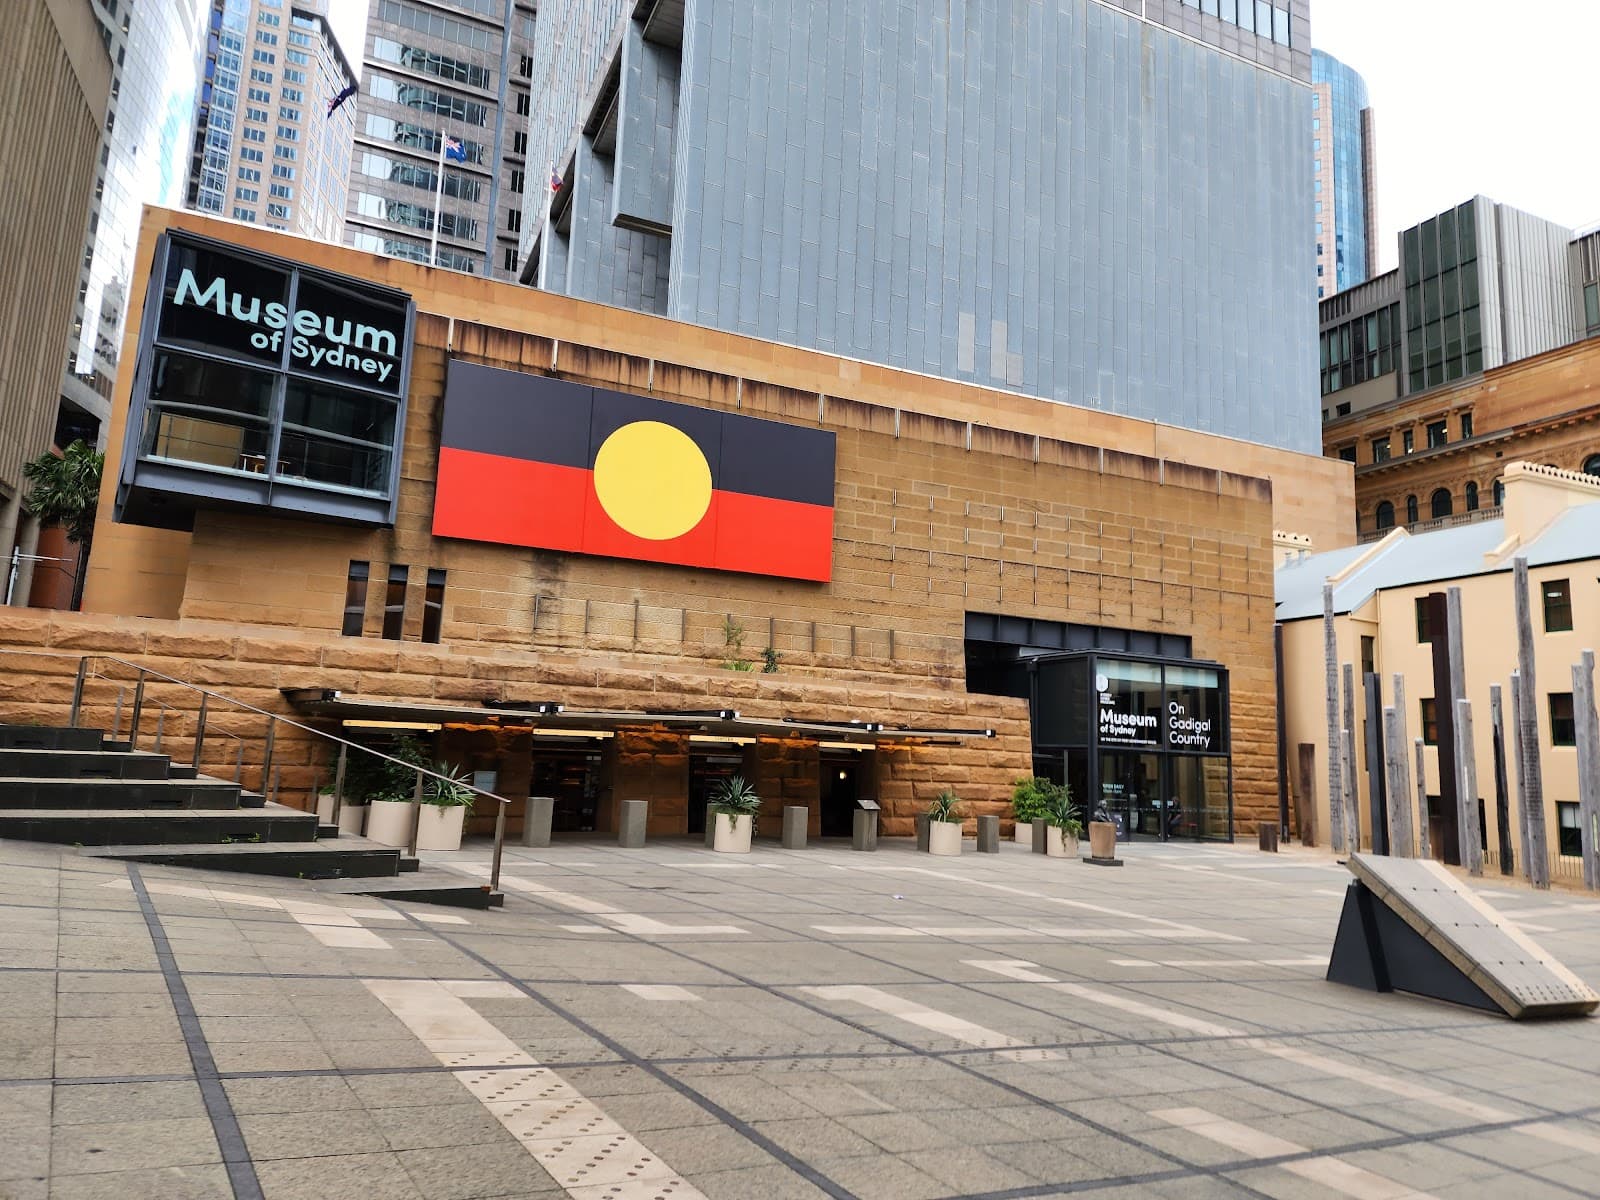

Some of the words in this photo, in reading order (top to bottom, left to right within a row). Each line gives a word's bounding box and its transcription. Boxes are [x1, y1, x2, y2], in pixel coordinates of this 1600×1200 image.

[173, 268, 397, 356] Museum
[250, 331, 285, 353] of
[291, 336, 393, 383] Sydney
[1168, 701, 1185, 715] On
[1100, 708, 1157, 728] Museum
[1169, 716, 1211, 733] Gadigal
[1100, 724, 1108, 734] of
[1109, 724, 1136, 737] Sydney
[1169, 731, 1211, 749] Country
